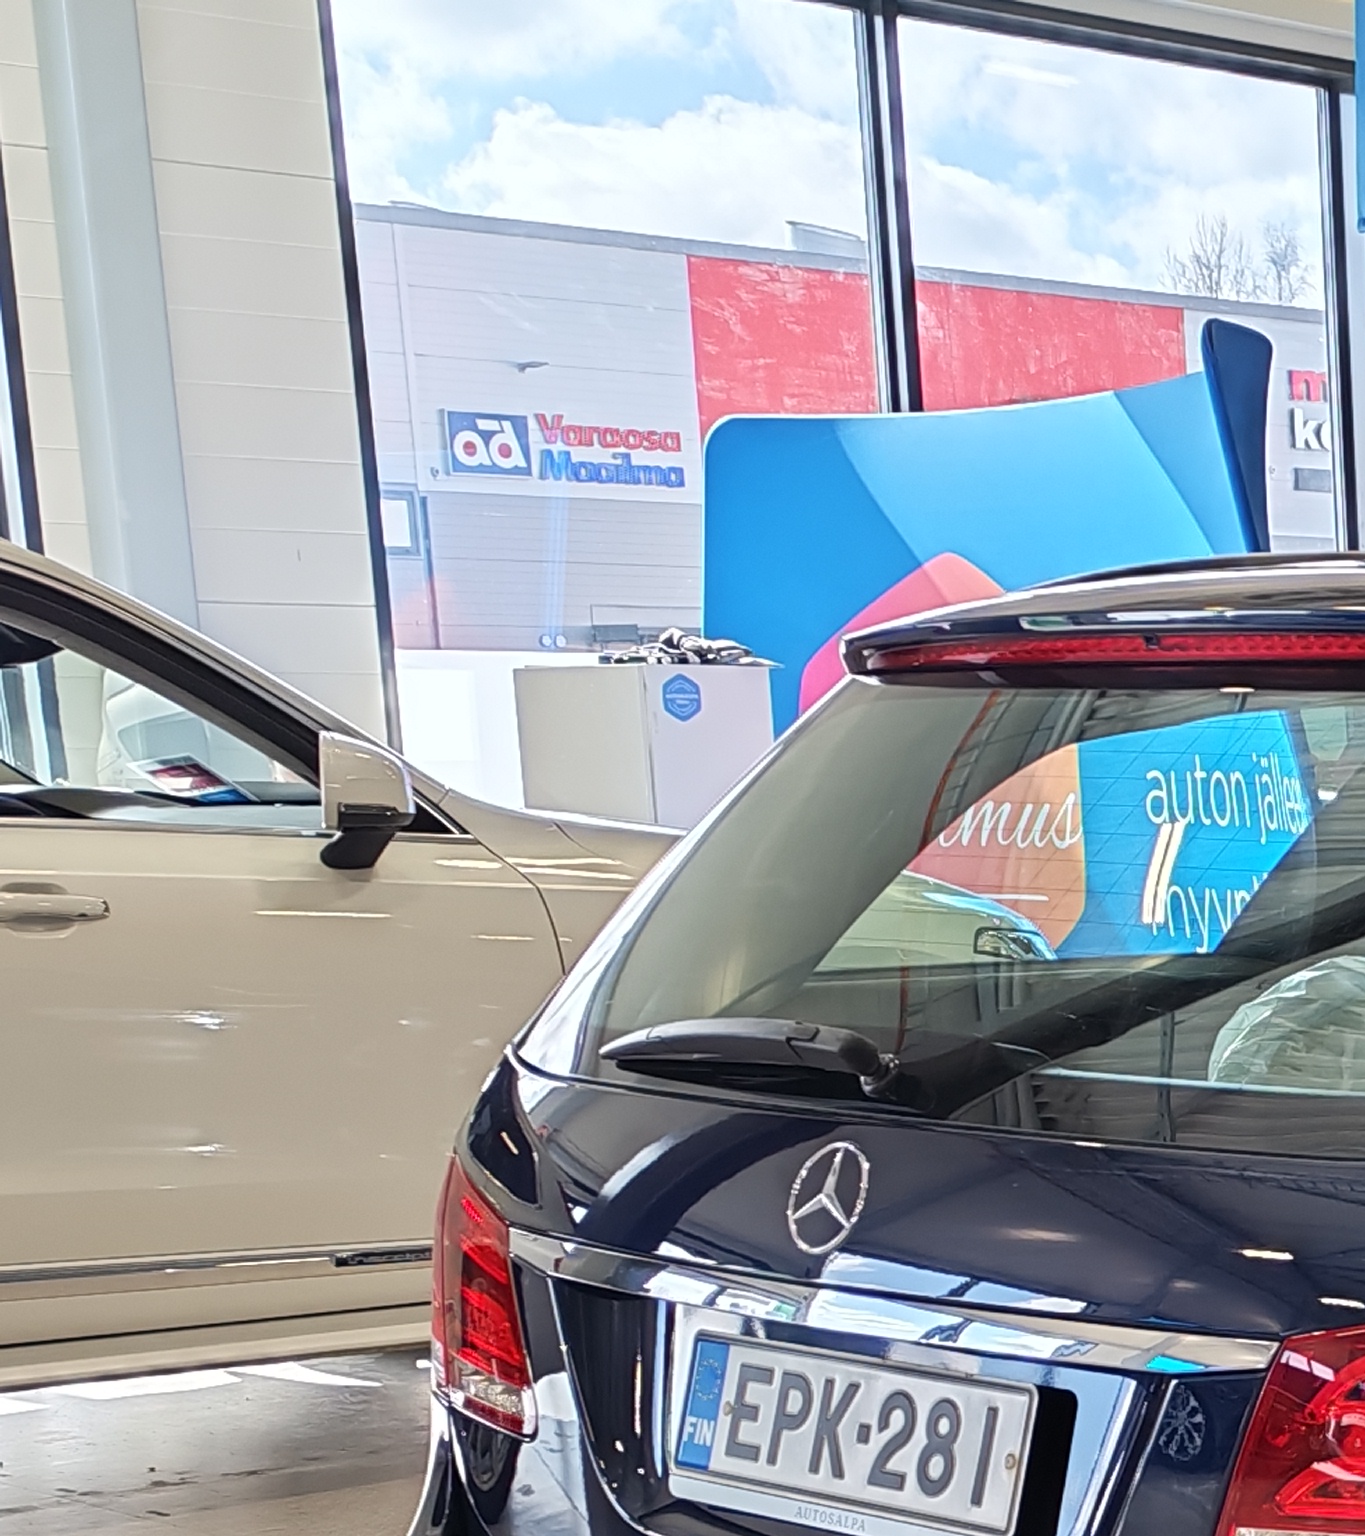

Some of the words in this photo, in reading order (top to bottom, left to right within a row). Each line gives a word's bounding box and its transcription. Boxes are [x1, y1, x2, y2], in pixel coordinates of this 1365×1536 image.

[534, 412, 682, 453] Varaosa
[1145, 754, 1251, 828] auton
[682, 1416, 714, 1448] FIN
[724, 1362, 999, 1509] EPK-281
[794, 1506, 866, 1532] AUTOSALPA
